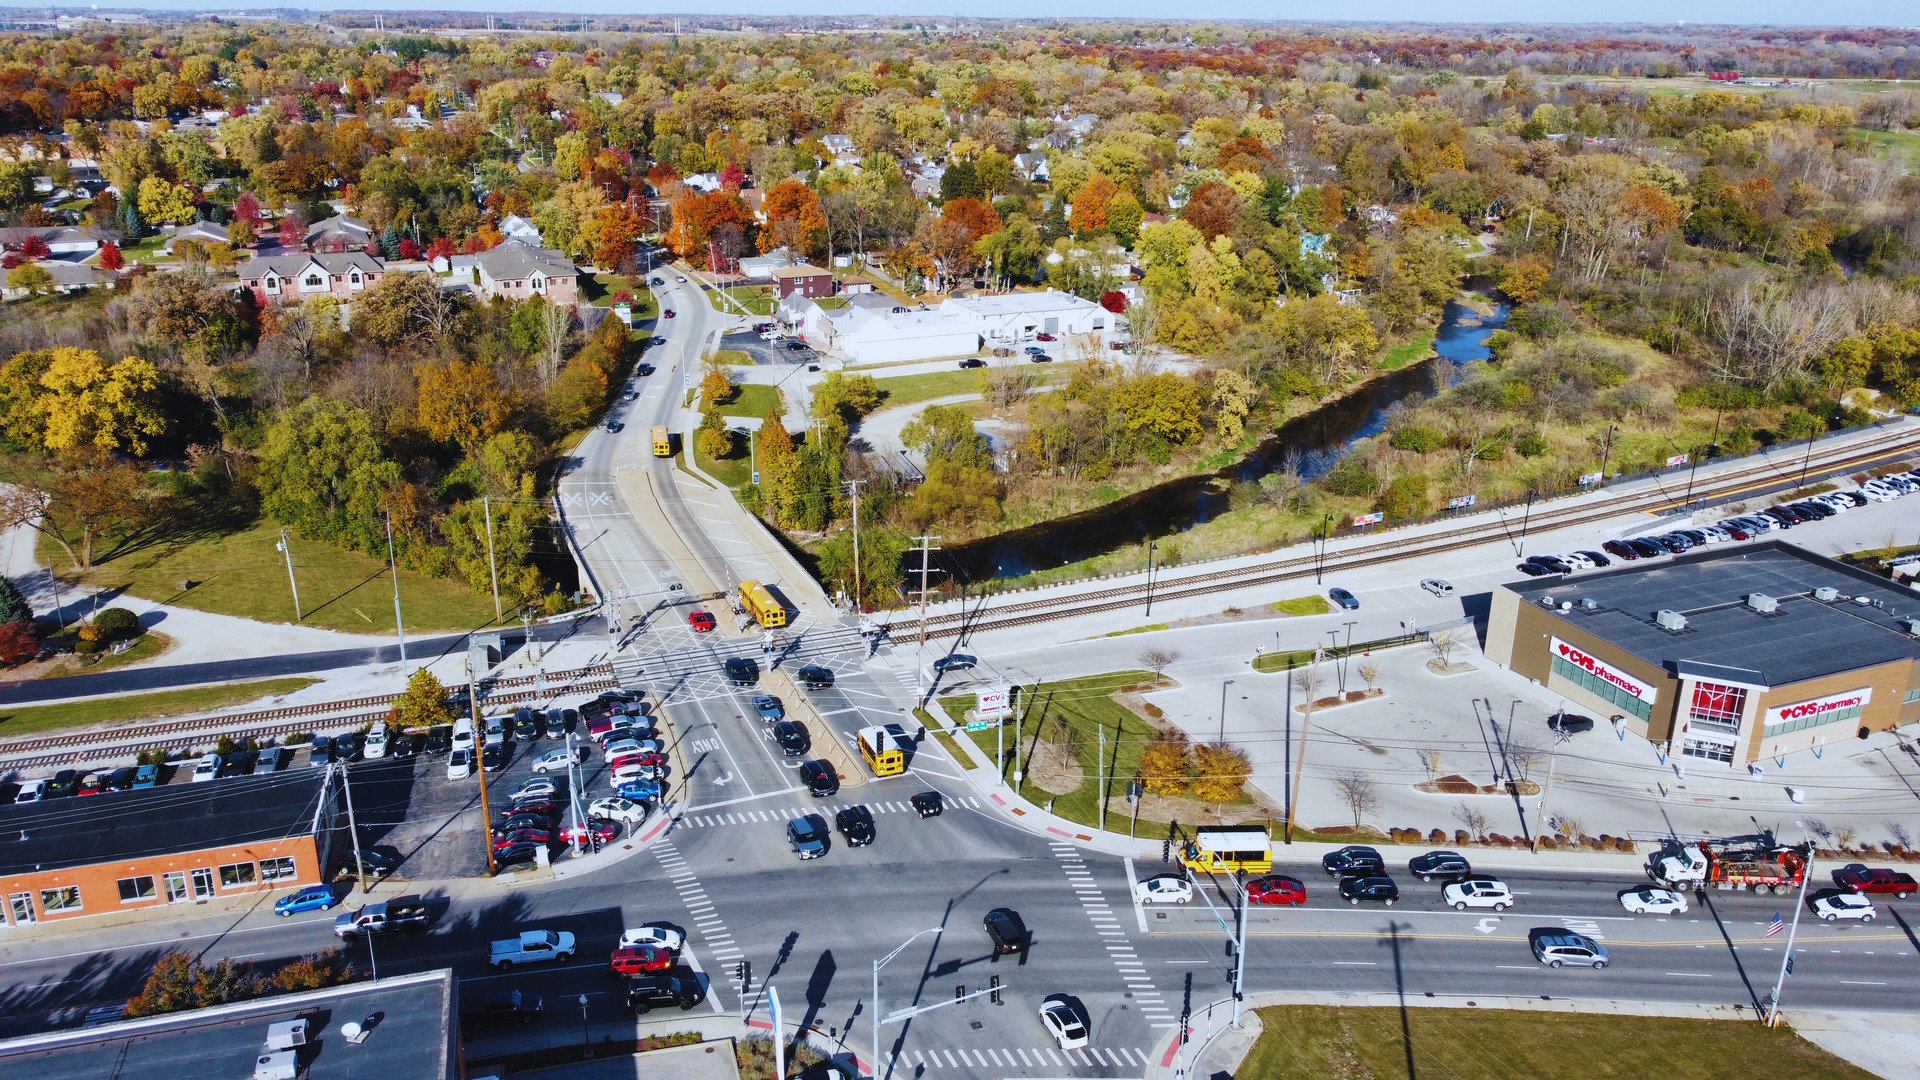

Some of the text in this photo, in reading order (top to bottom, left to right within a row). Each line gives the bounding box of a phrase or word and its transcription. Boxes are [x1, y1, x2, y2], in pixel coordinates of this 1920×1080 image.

[1570, 650, 1643, 699] CVS pharmacy
[990, 694, 1005, 702] CV
[1791, 696, 1863, 719] CVS pharmacy
[691, 737, 720, 754] ONLY
